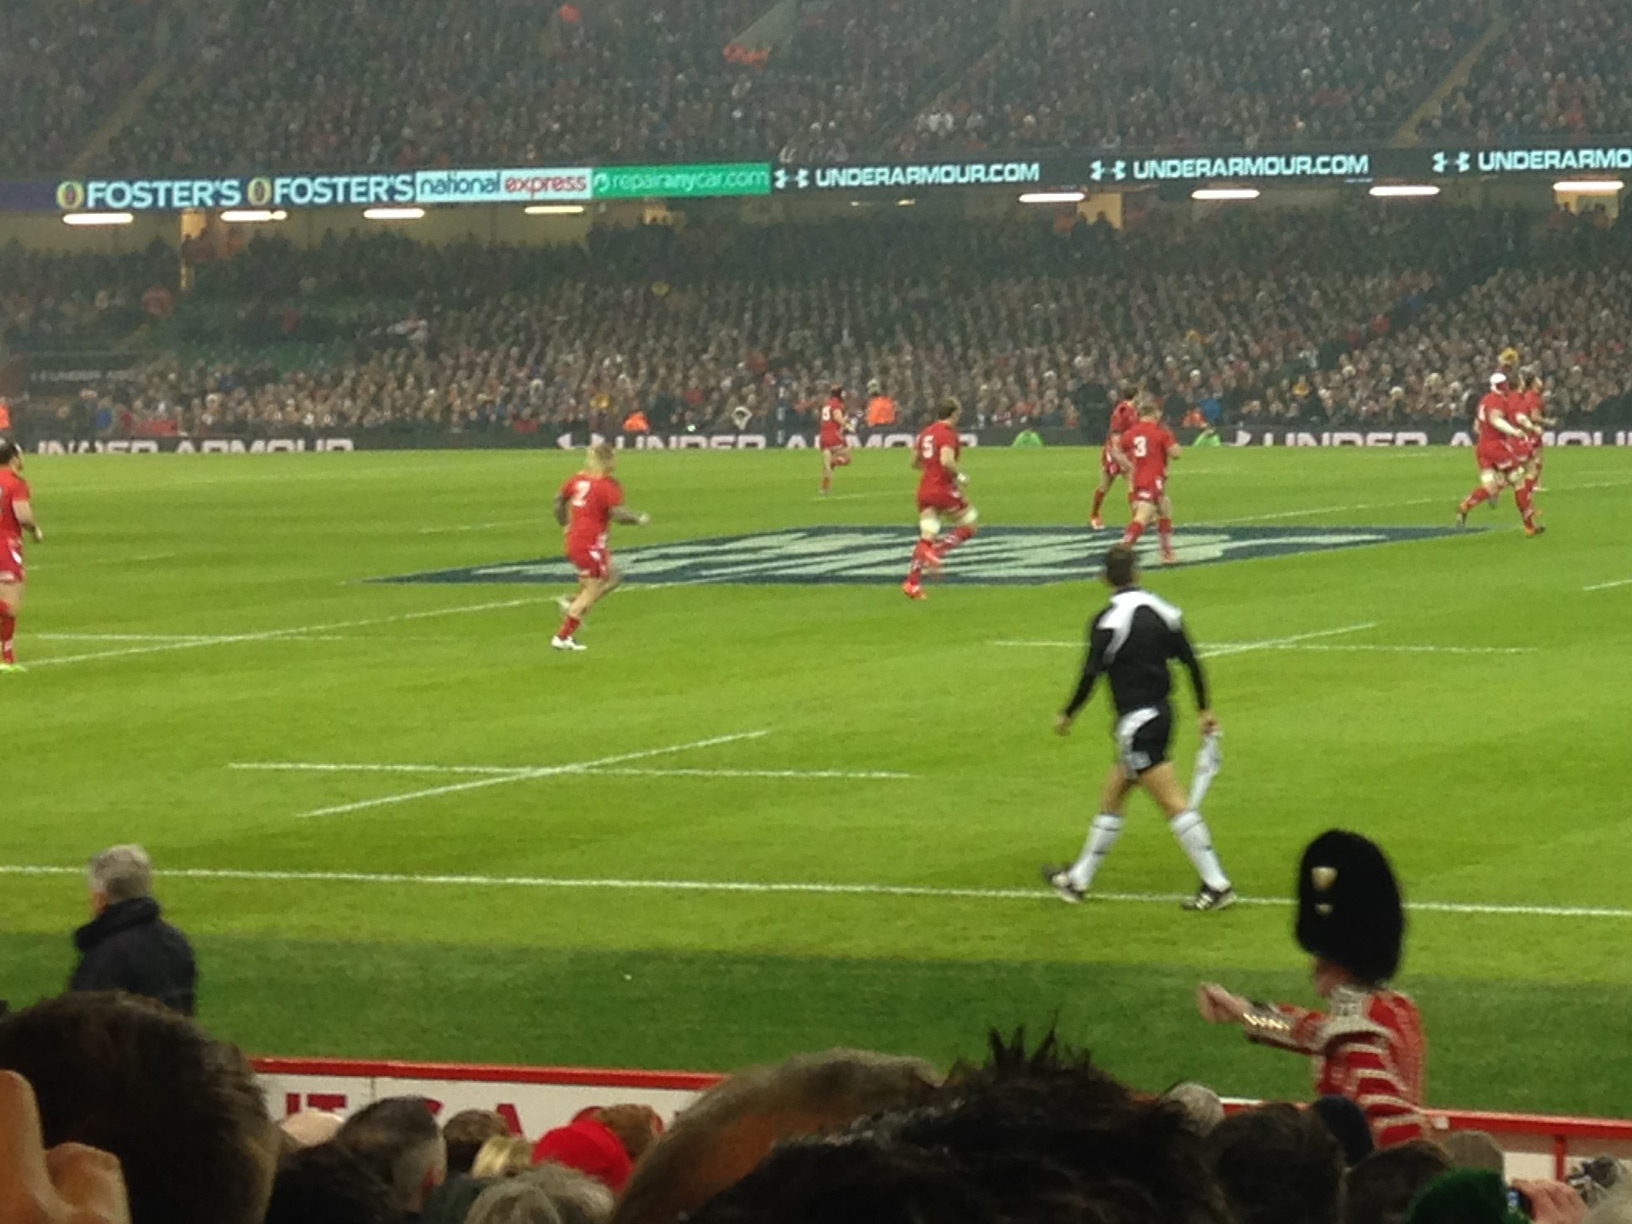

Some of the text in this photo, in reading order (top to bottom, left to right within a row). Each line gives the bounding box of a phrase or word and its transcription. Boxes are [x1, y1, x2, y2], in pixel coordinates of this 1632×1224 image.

[815, 162, 1040, 187] UNDERARMOUR.COM
[1132, 154, 1369, 179] UNDERARMOUR.COM
[87, 179, 241, 209] FOSTER'S
[274, 174, 412, 205] FOSTER'S
[420, 171, 587, 201] national express
[611, 169, 767, 194] repairanycar.com
[1132, 435, 1147, 457] 3
